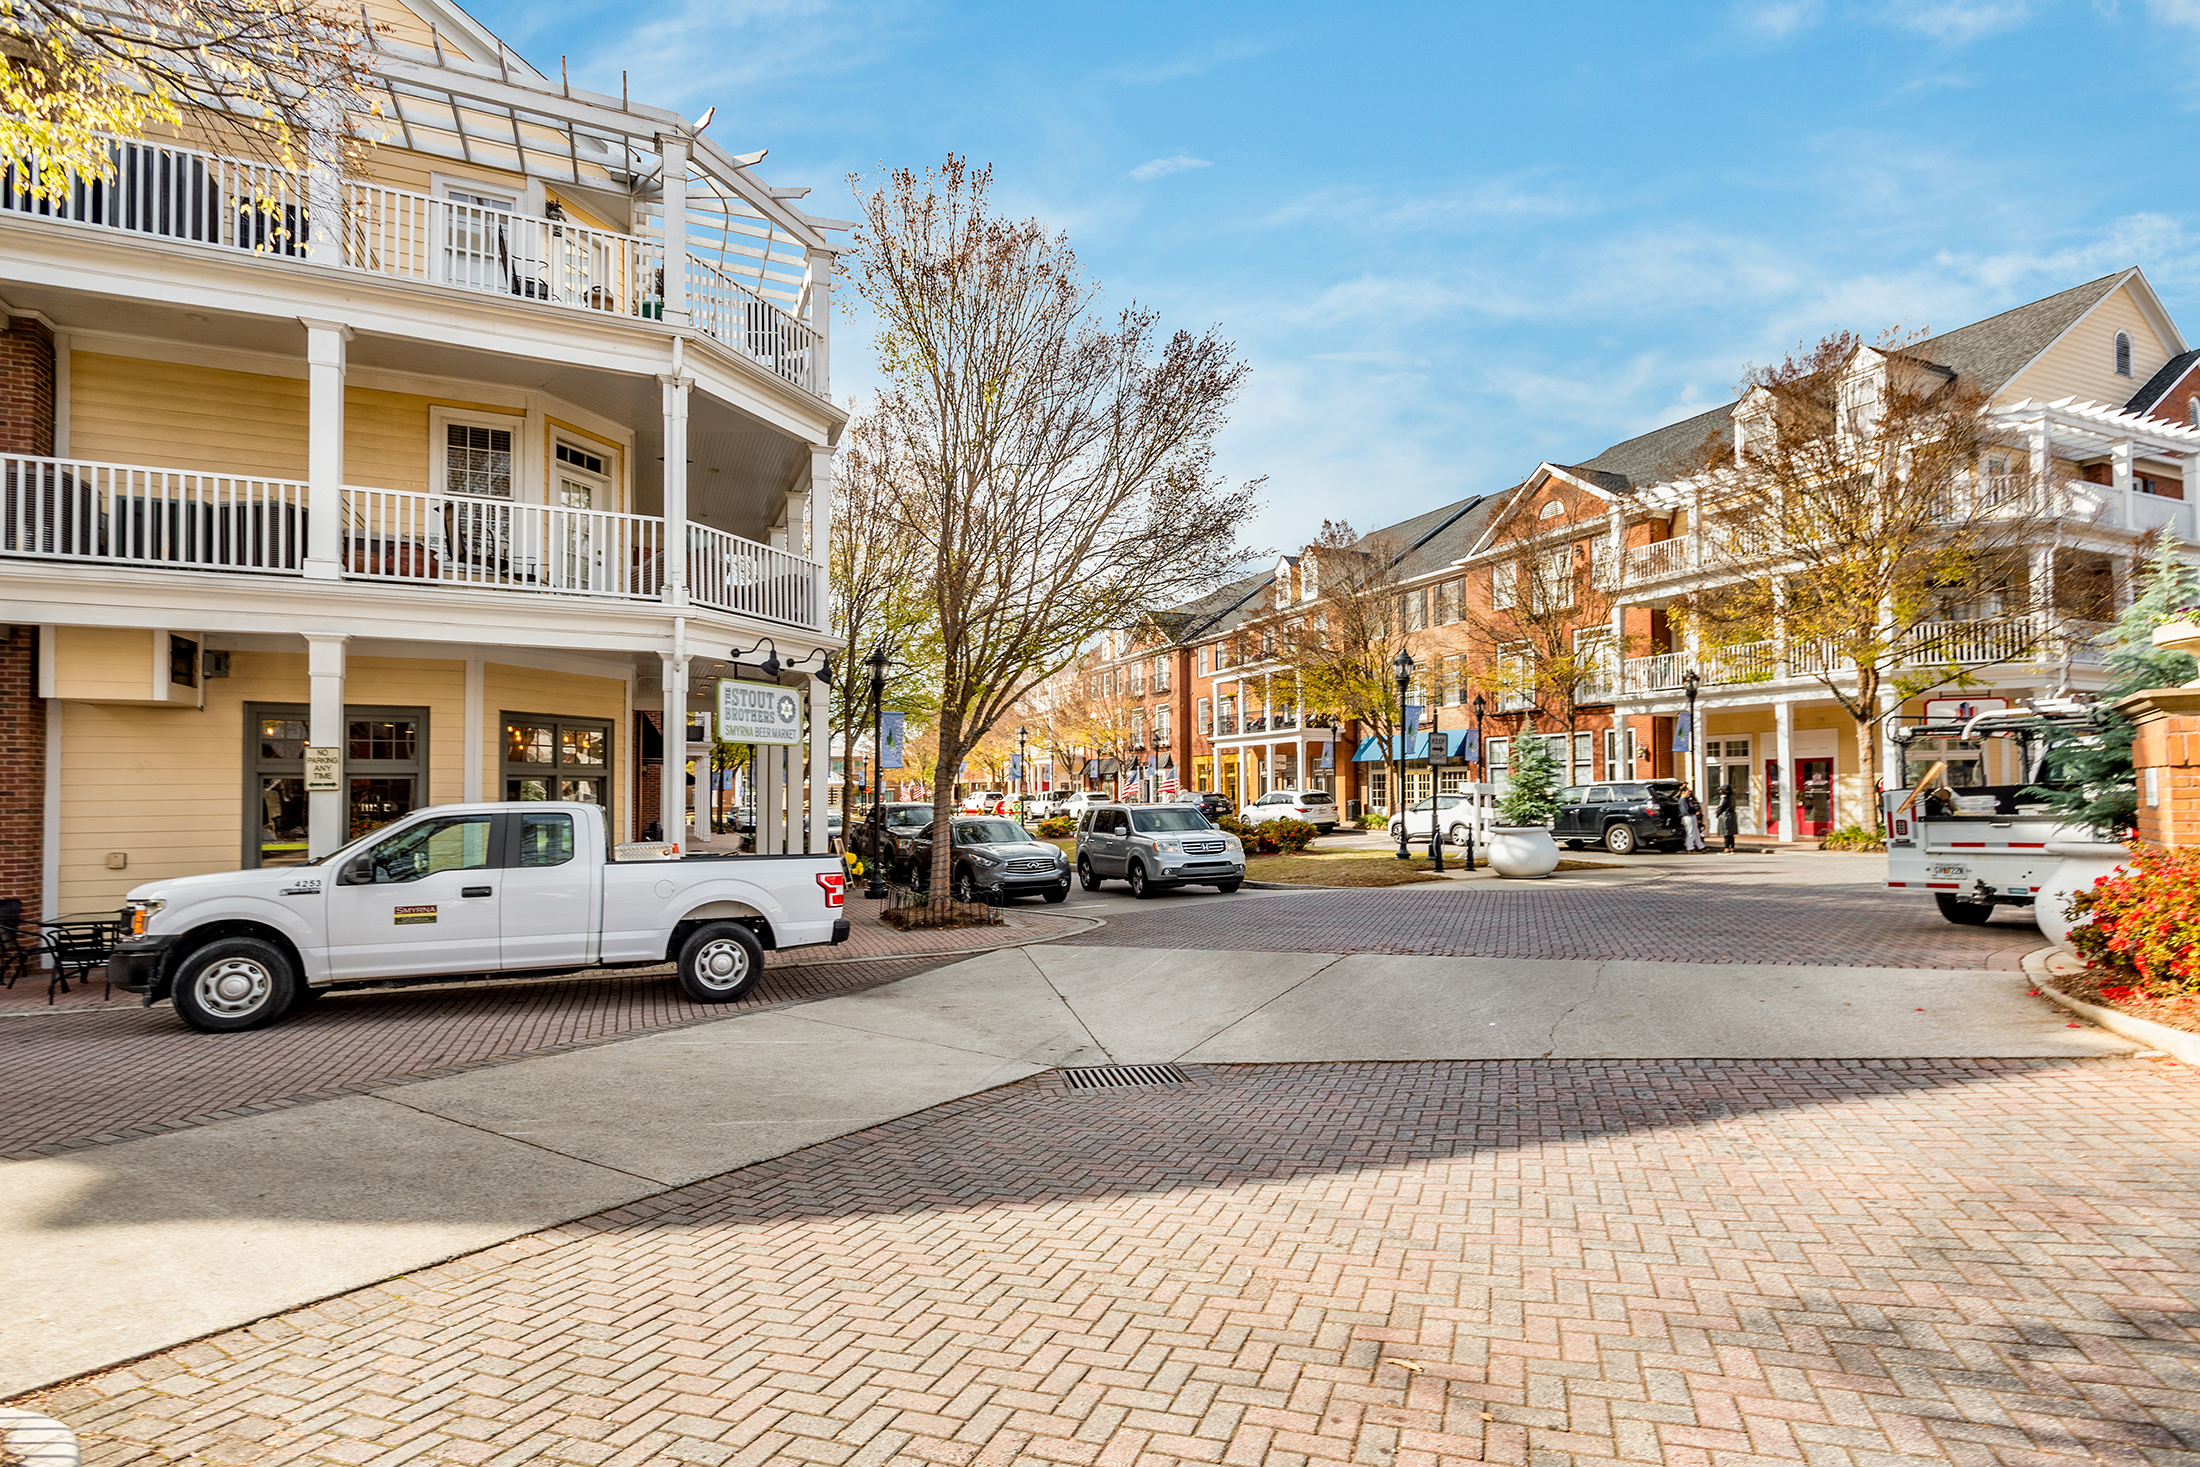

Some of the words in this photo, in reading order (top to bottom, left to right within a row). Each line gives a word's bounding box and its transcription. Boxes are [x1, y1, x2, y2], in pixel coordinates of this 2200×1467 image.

[731, 688, 775, 709] STOUT
[724, 707, 775, 724] BROTHERS
[725, 725, 754, 737] SMYRNA
[755, 727, 771, 738] BEER
[772, 728, 796, 740] MARKET
[894, 717, 904, 760] SMYRNA
[396, 906, 435, 914] SMYRNA
